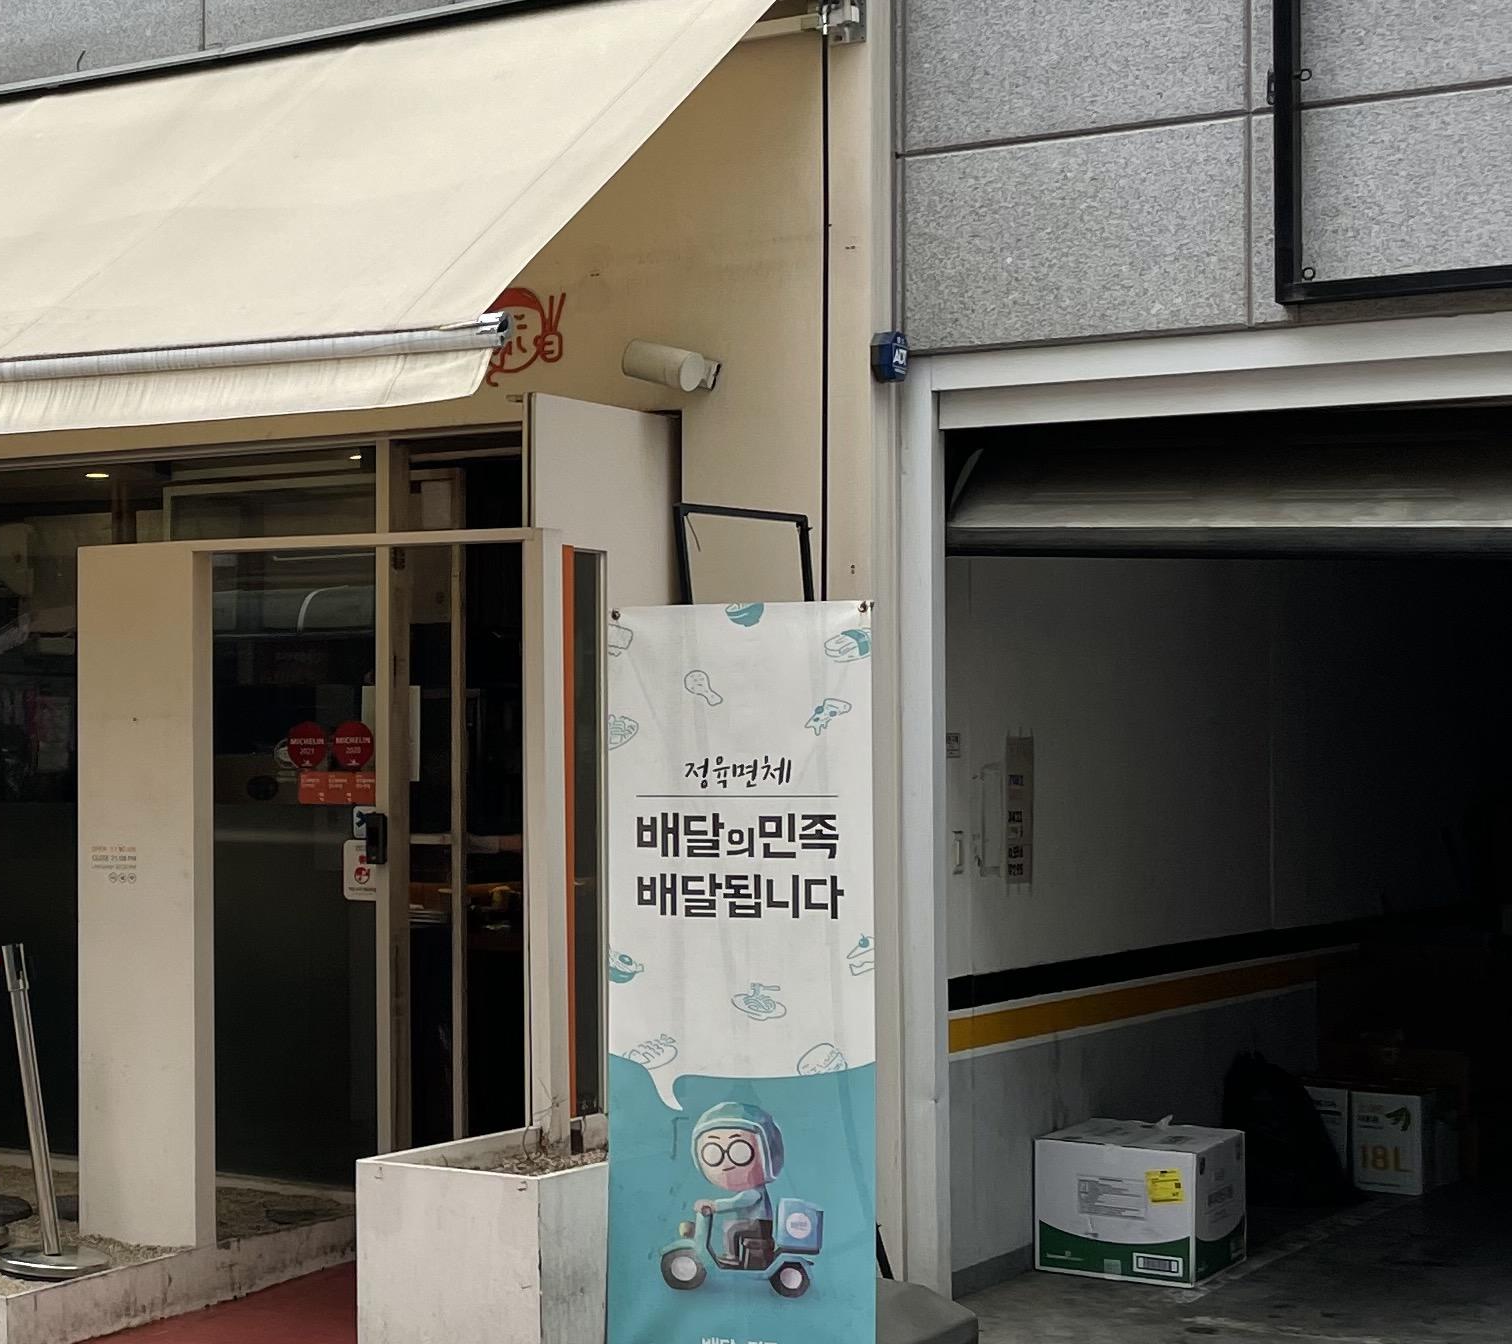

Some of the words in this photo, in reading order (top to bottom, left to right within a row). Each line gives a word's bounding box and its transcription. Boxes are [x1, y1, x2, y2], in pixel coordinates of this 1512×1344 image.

[290, 737, 325, 746] MICHELIN
[335, 736, 371, 745] MICHELIN
[684, 755, 792, 789] 정육면체
[636, 811, 840, 860] 배달의민족
[636, 872, 845, 920] 배달됩니다
